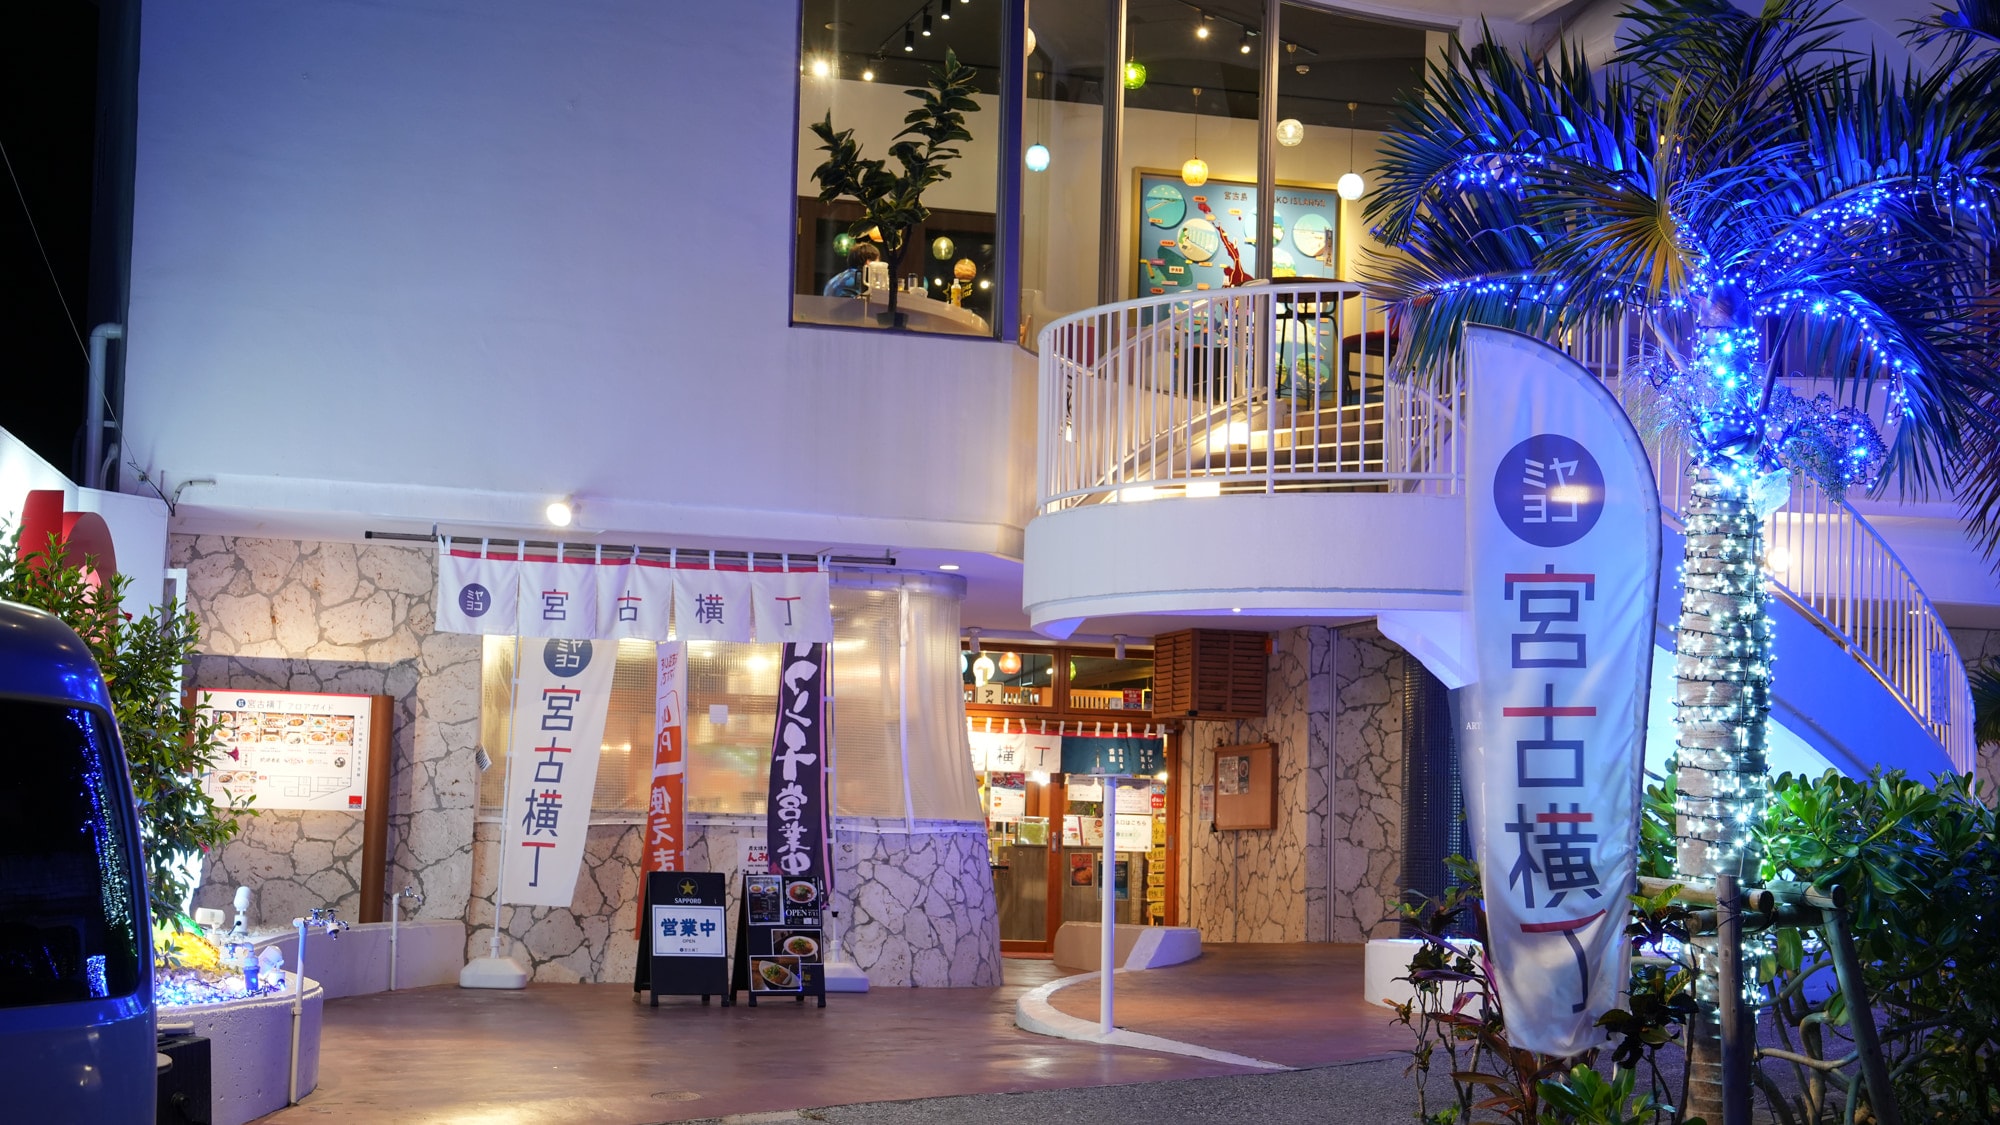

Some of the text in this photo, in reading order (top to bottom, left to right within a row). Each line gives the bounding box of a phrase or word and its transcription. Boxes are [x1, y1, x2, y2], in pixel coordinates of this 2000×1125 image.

[1290, 196, 1326, 208] ISLANDS
[542, 588, 801, 626] 宮古横丁
[522, 685, 581, 887] 宮古横丁
[1503, 564, 1606, 1013] 宮古横丁
[674, 897, 702, 905] SAPPORO
[785, 909, 807, 917] OPEN
[660, 917, 716, 938] 営業中
